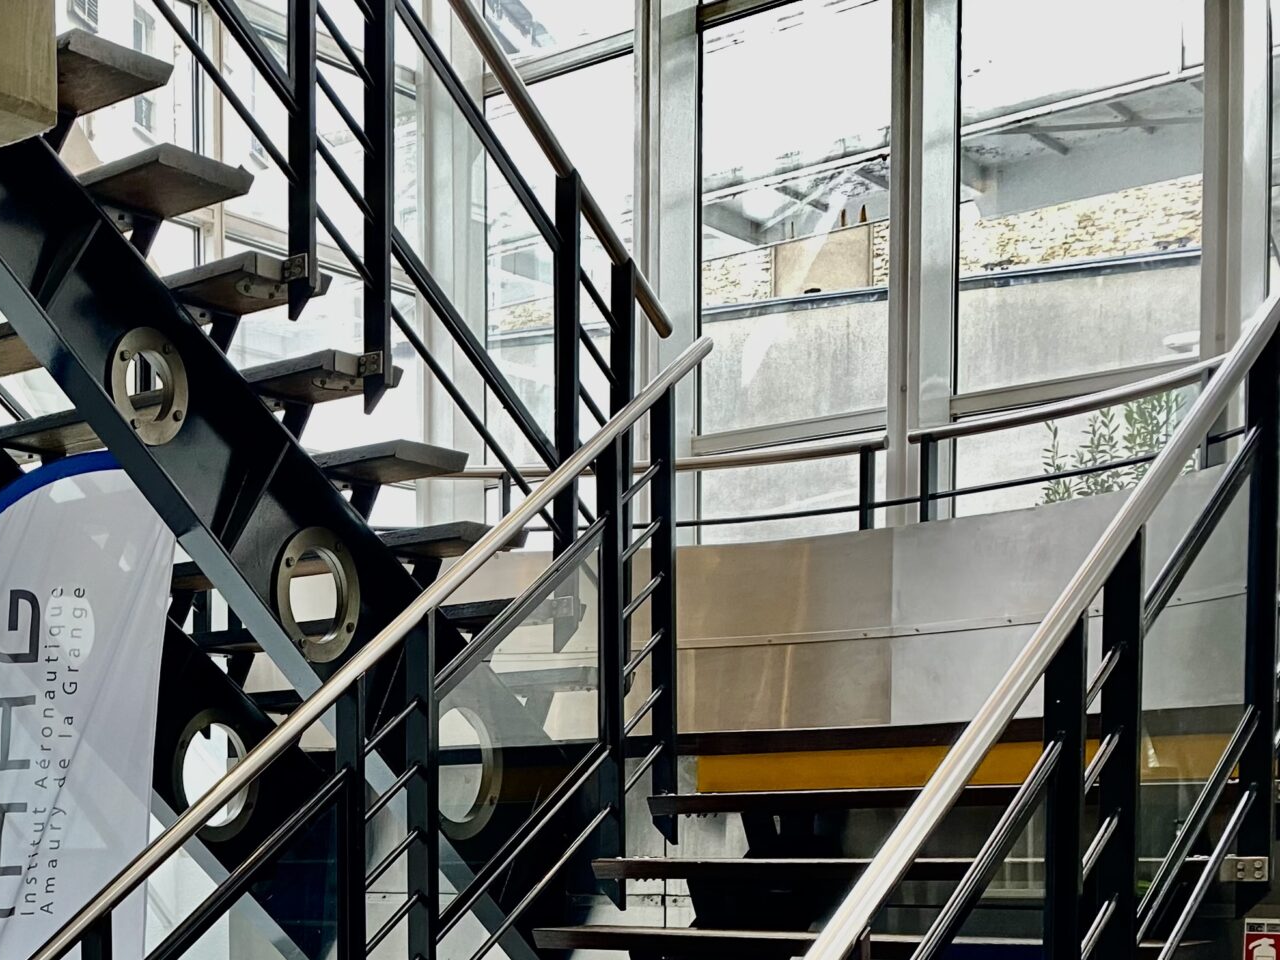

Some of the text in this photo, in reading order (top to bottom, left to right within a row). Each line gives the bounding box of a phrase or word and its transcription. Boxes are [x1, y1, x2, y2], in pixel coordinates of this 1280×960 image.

[20, 587, 65, 916] Institut Aéronautique
[40, 587, 88, 915] Amaury de la Grange
